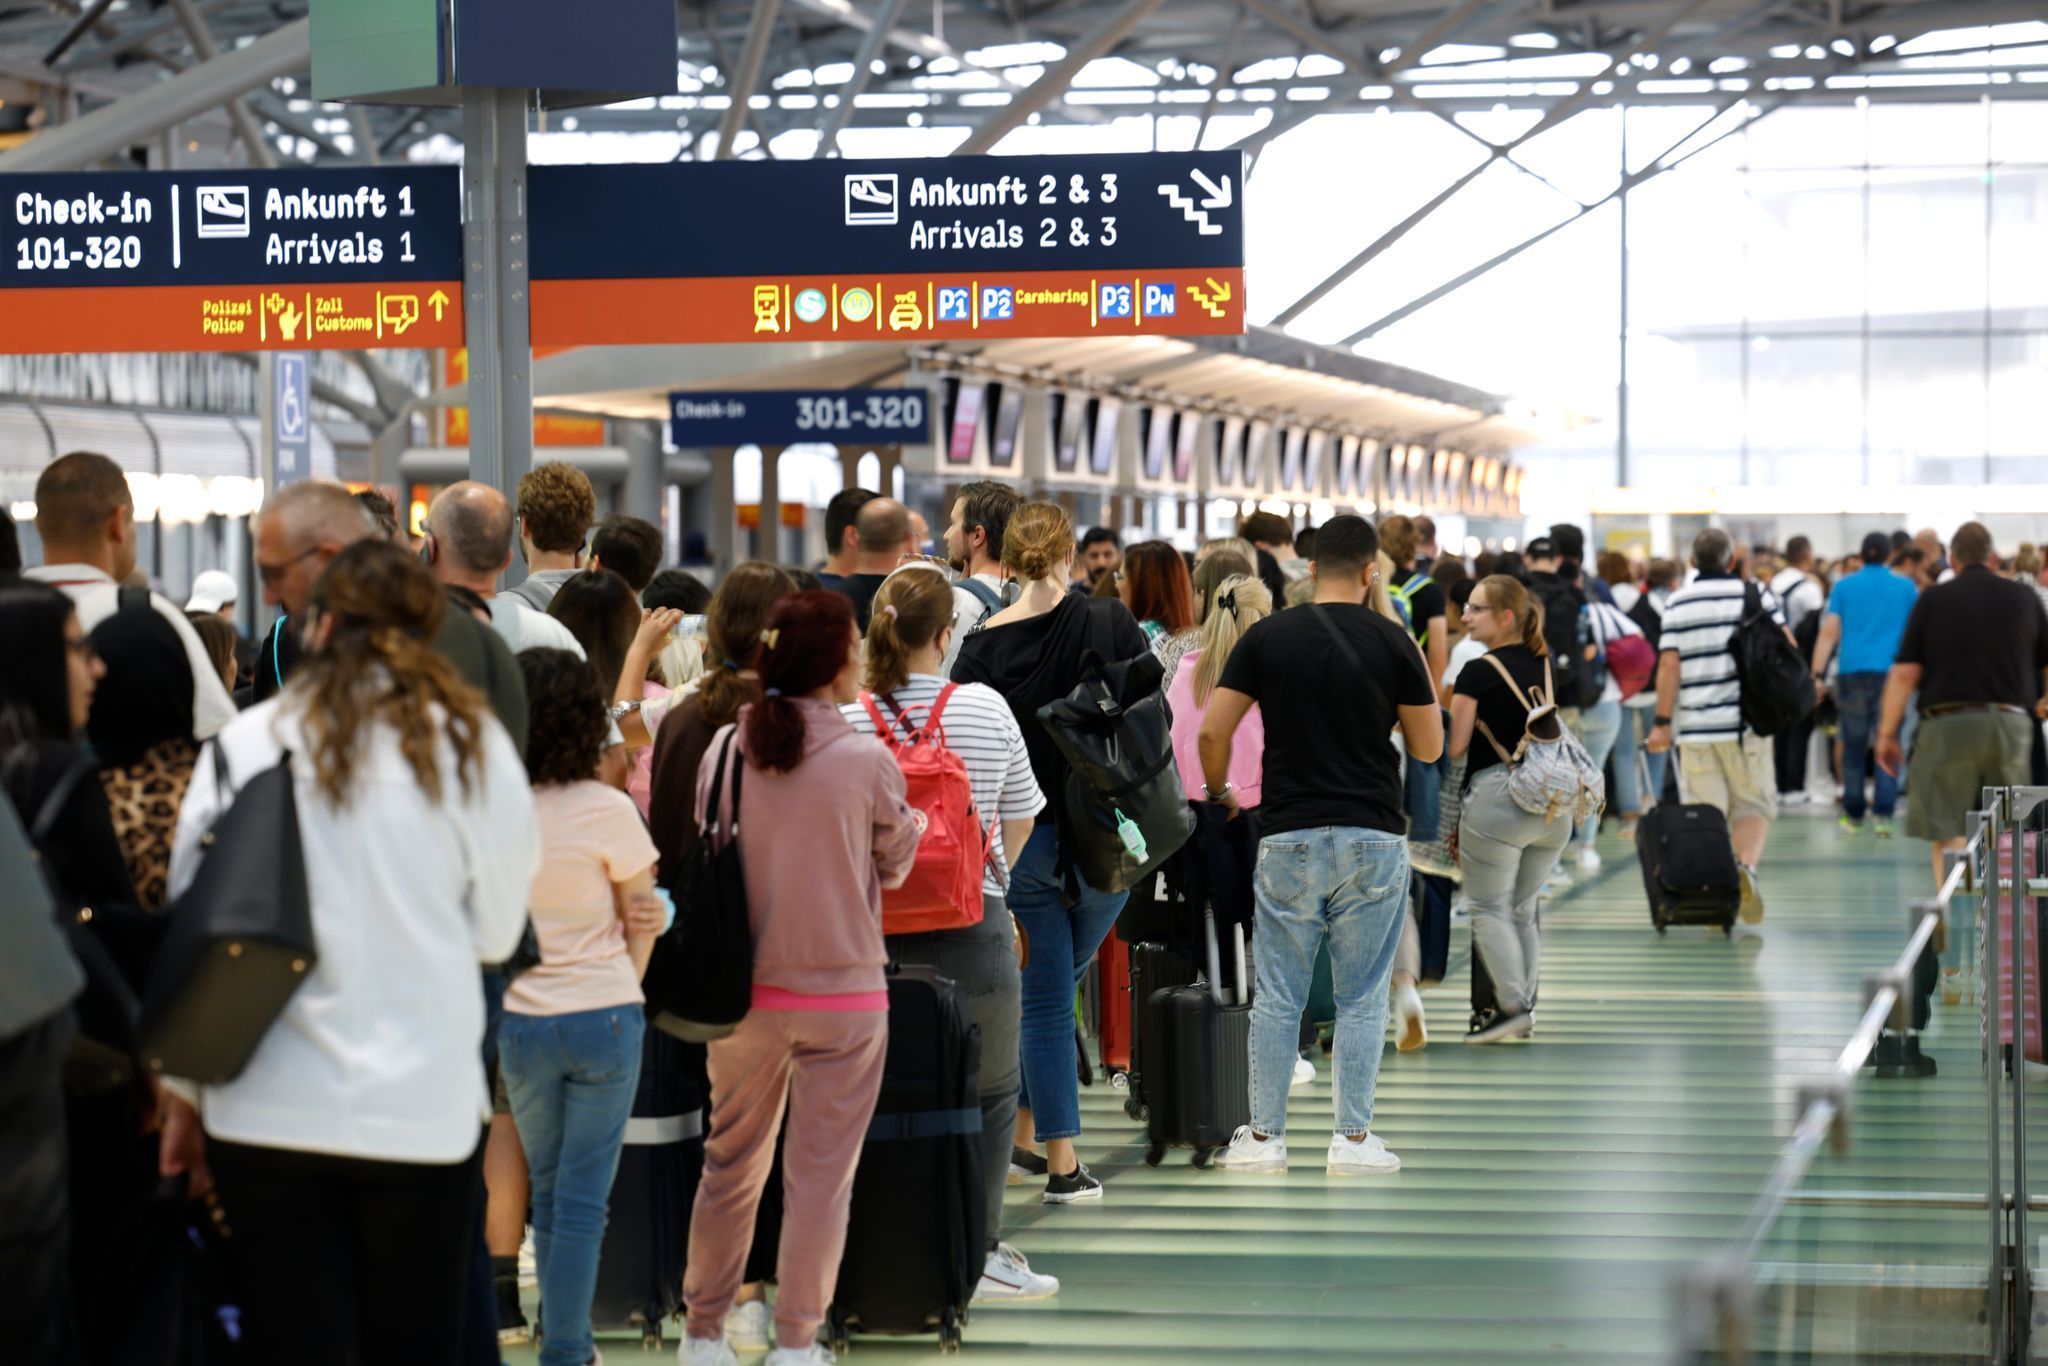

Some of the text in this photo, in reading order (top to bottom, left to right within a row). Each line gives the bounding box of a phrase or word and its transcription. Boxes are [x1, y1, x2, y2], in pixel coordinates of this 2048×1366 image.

[264, 186, 415, 220] Ankunft 1
[909, 173, 1118, 208] Ankunft 2 & 3
[15, 191, 152, 225] Check-in
[265, 230, 416, 265] Arrivals 1
[910, 216, 1117, 250] Arrivals 2 & 3
[17, 235, 141, 270] 101-320
[203, 300, 253, 316] Polizei
[315, 298, 344, 314] Zoll
[982, 288, 1011, 318] P2
[1015, 288, 1089, 307] Carsharing
[1101, 286, 1131, 315] P3
[203, 317, 246, 335] Police
[315, 314, 374, 332] Customs
[676, 396, 923, 429] Check-in 301-320
